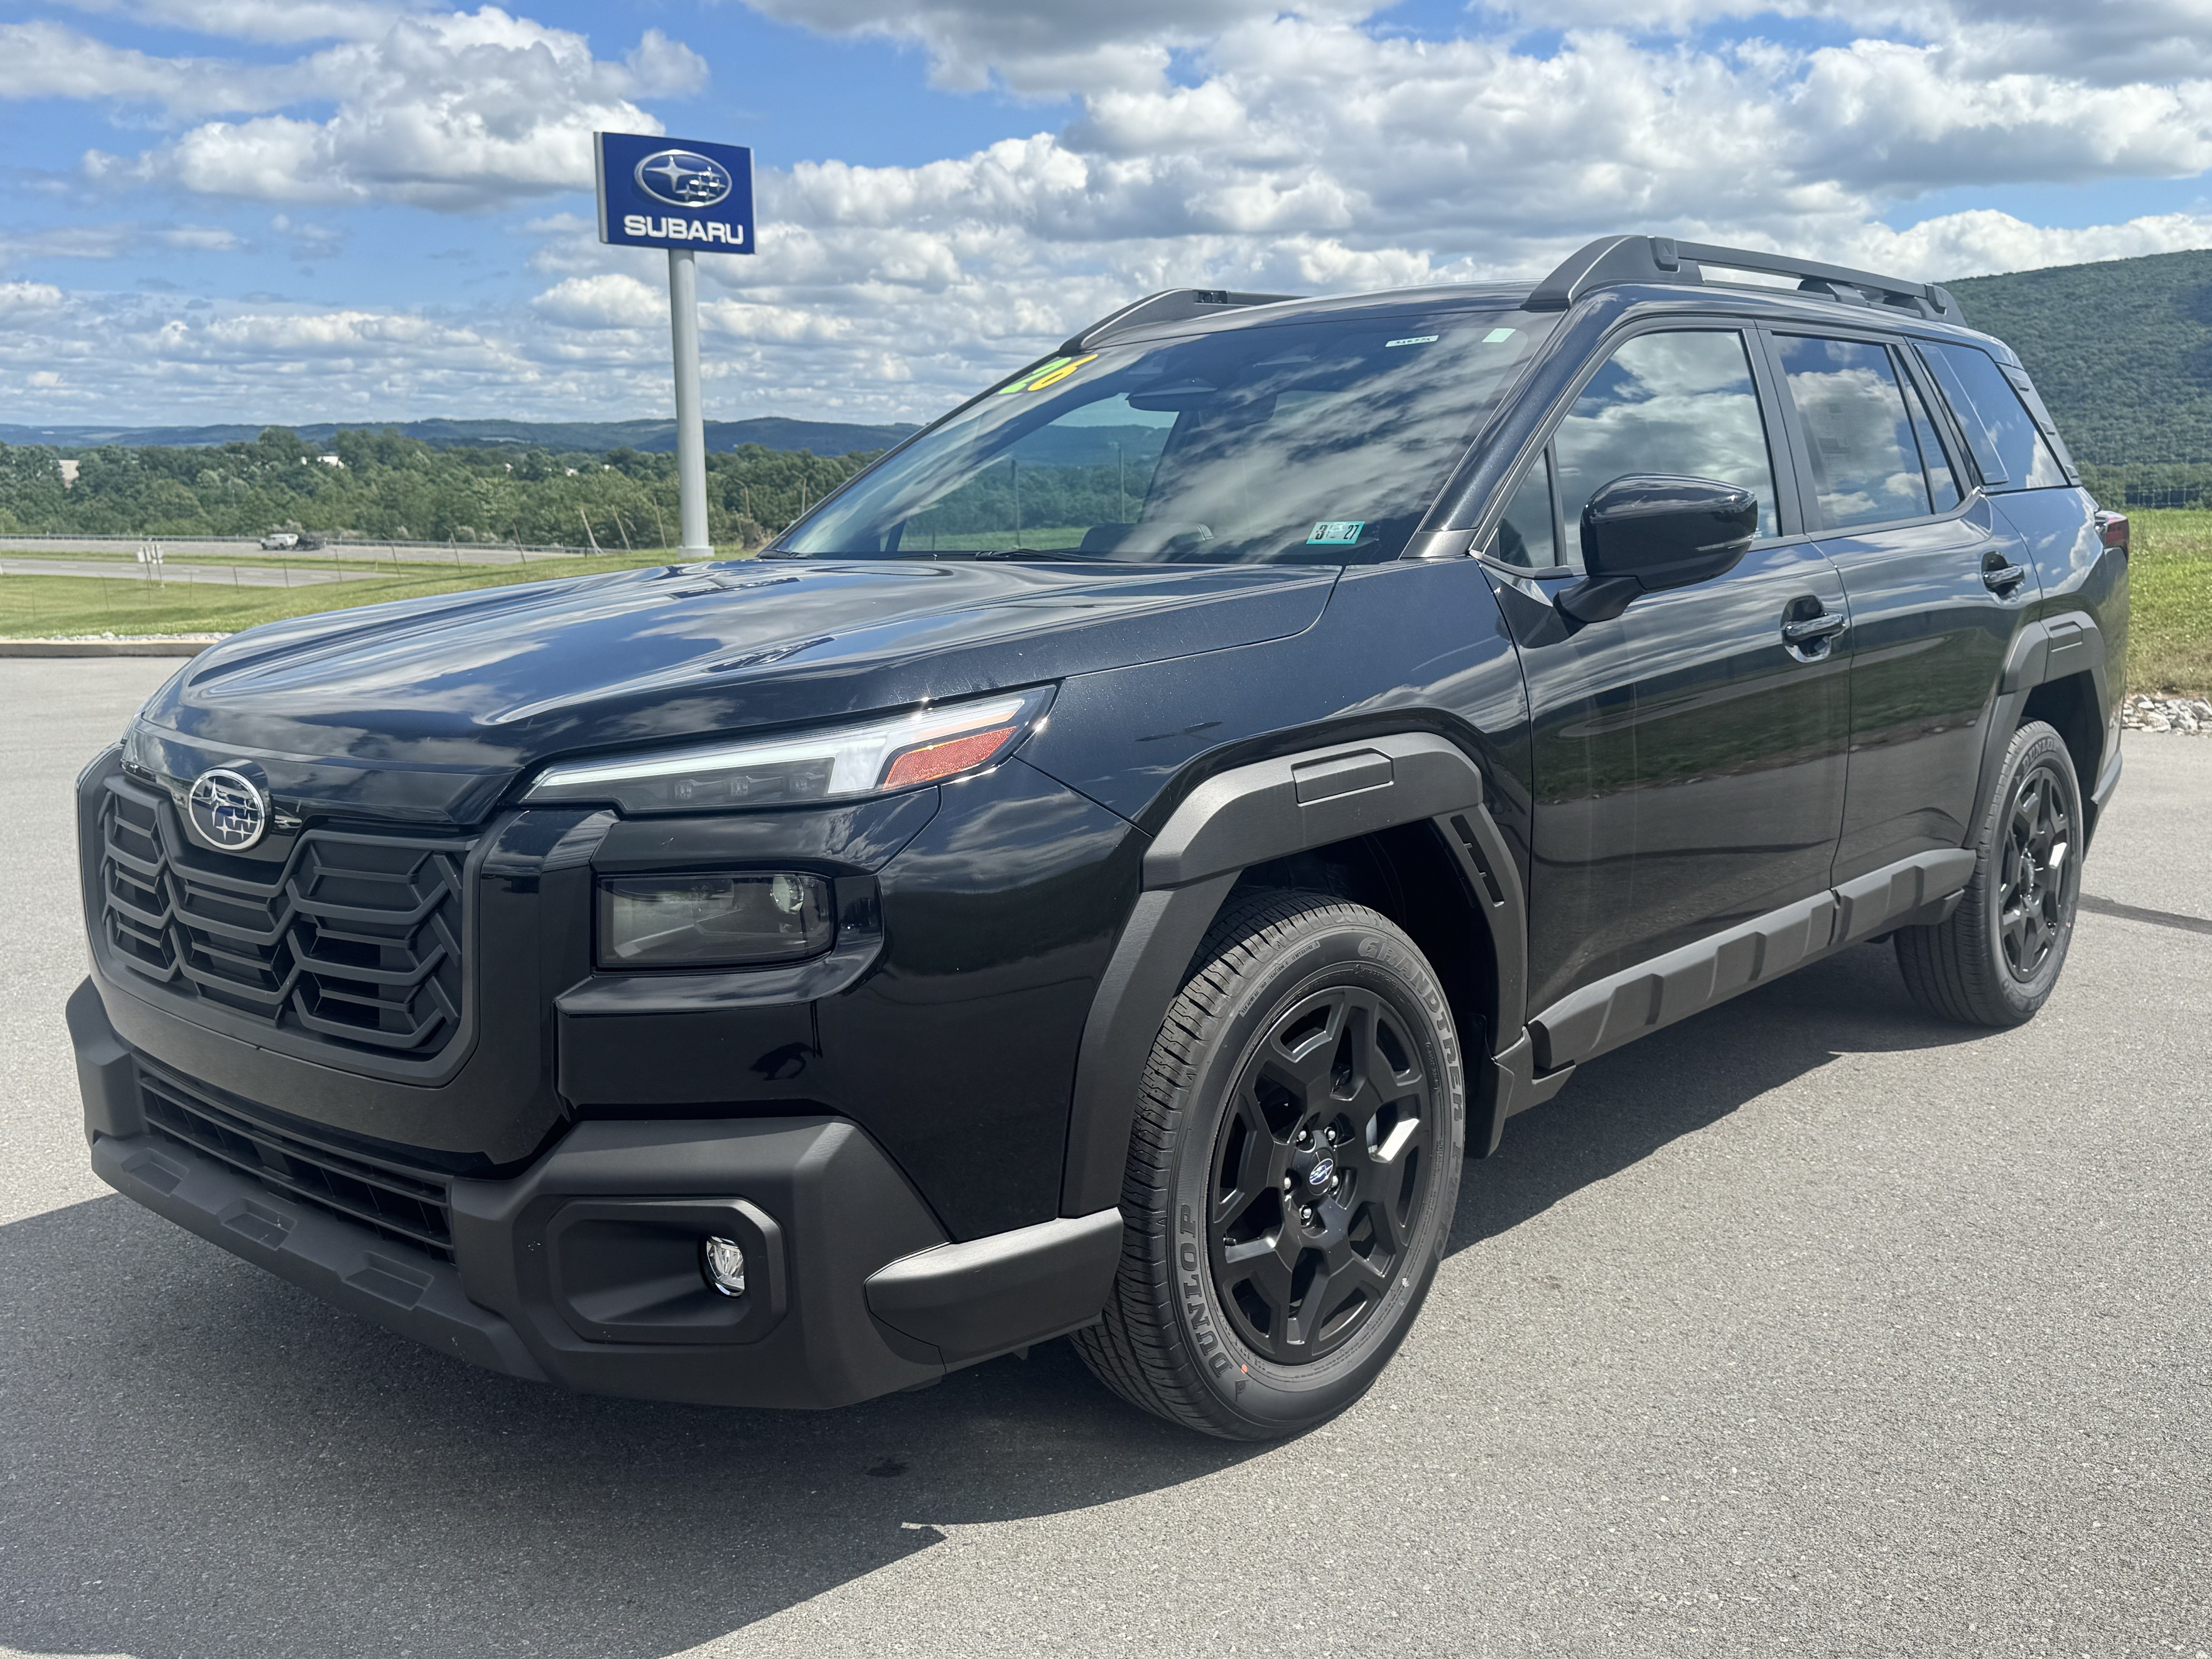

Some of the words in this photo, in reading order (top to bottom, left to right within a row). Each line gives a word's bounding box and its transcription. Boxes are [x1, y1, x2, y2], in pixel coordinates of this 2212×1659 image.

[623, 214, 744, 245] SUBARU
[998, 353, 1099, 394] 26
[1315, 524, 1328, 540] 3
[1343, 524, 1360, 540] 27
[1180, 1203, 1233, 1378] DUNLOP
